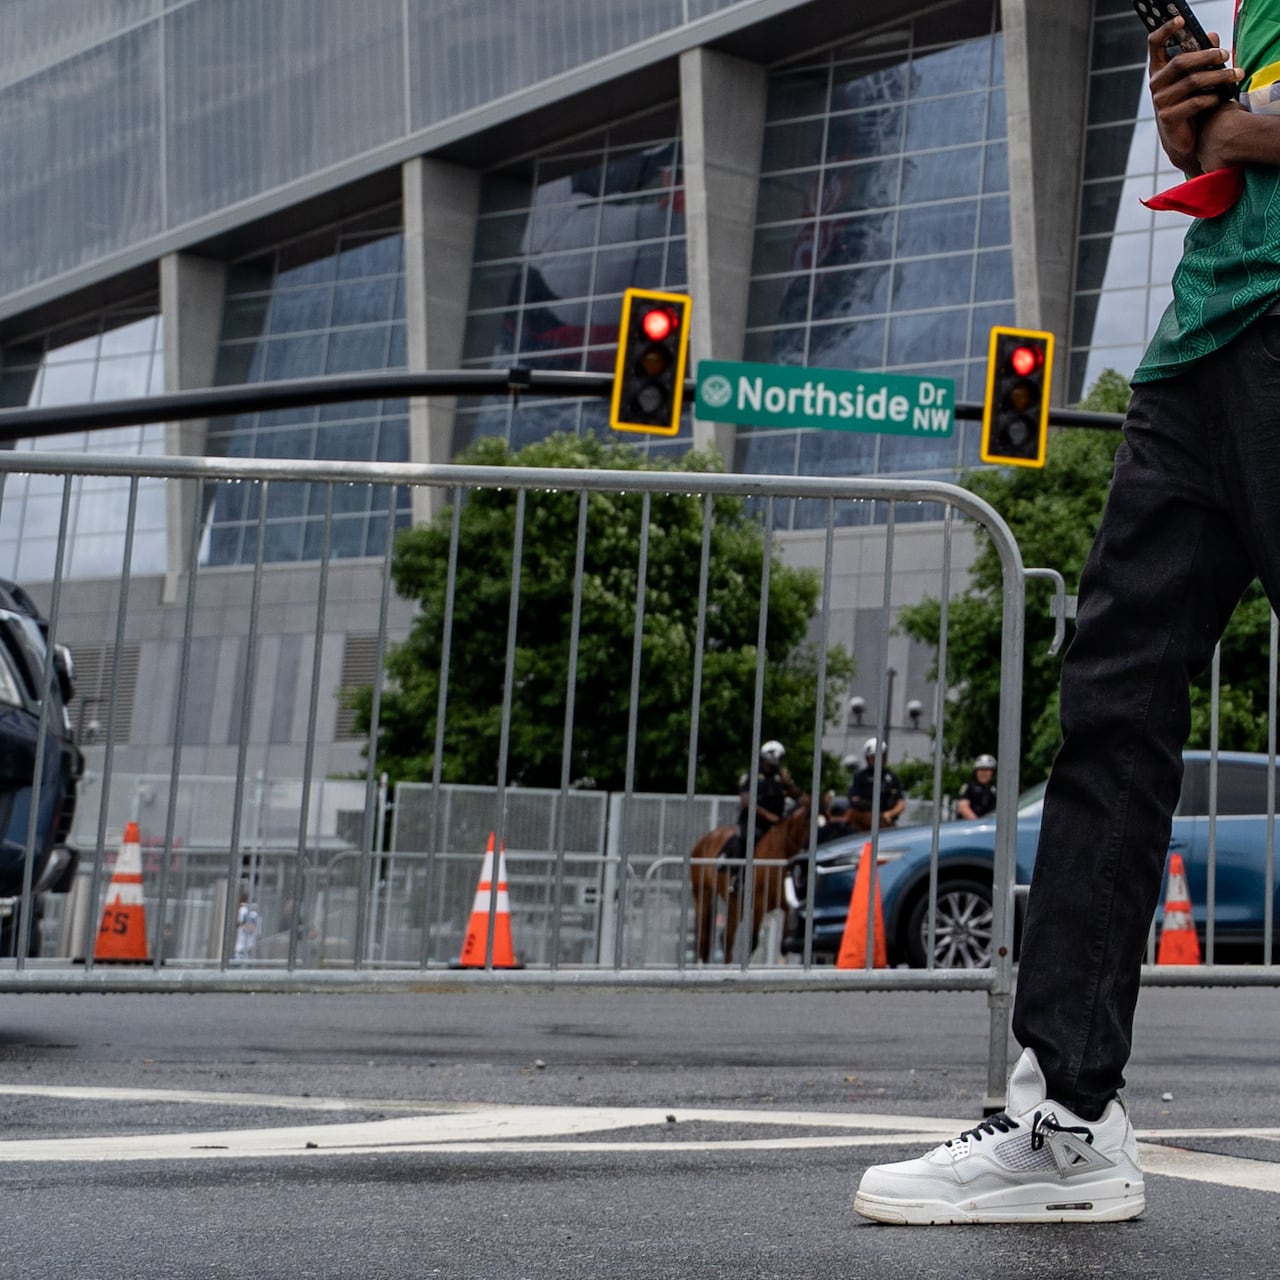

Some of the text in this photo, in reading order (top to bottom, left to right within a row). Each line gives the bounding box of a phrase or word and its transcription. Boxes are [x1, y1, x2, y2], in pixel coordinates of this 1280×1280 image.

[736, 375, 910, 422] Northside
[918, 381, 947, 406] Dr
[912, 407, 950, 433] NW
